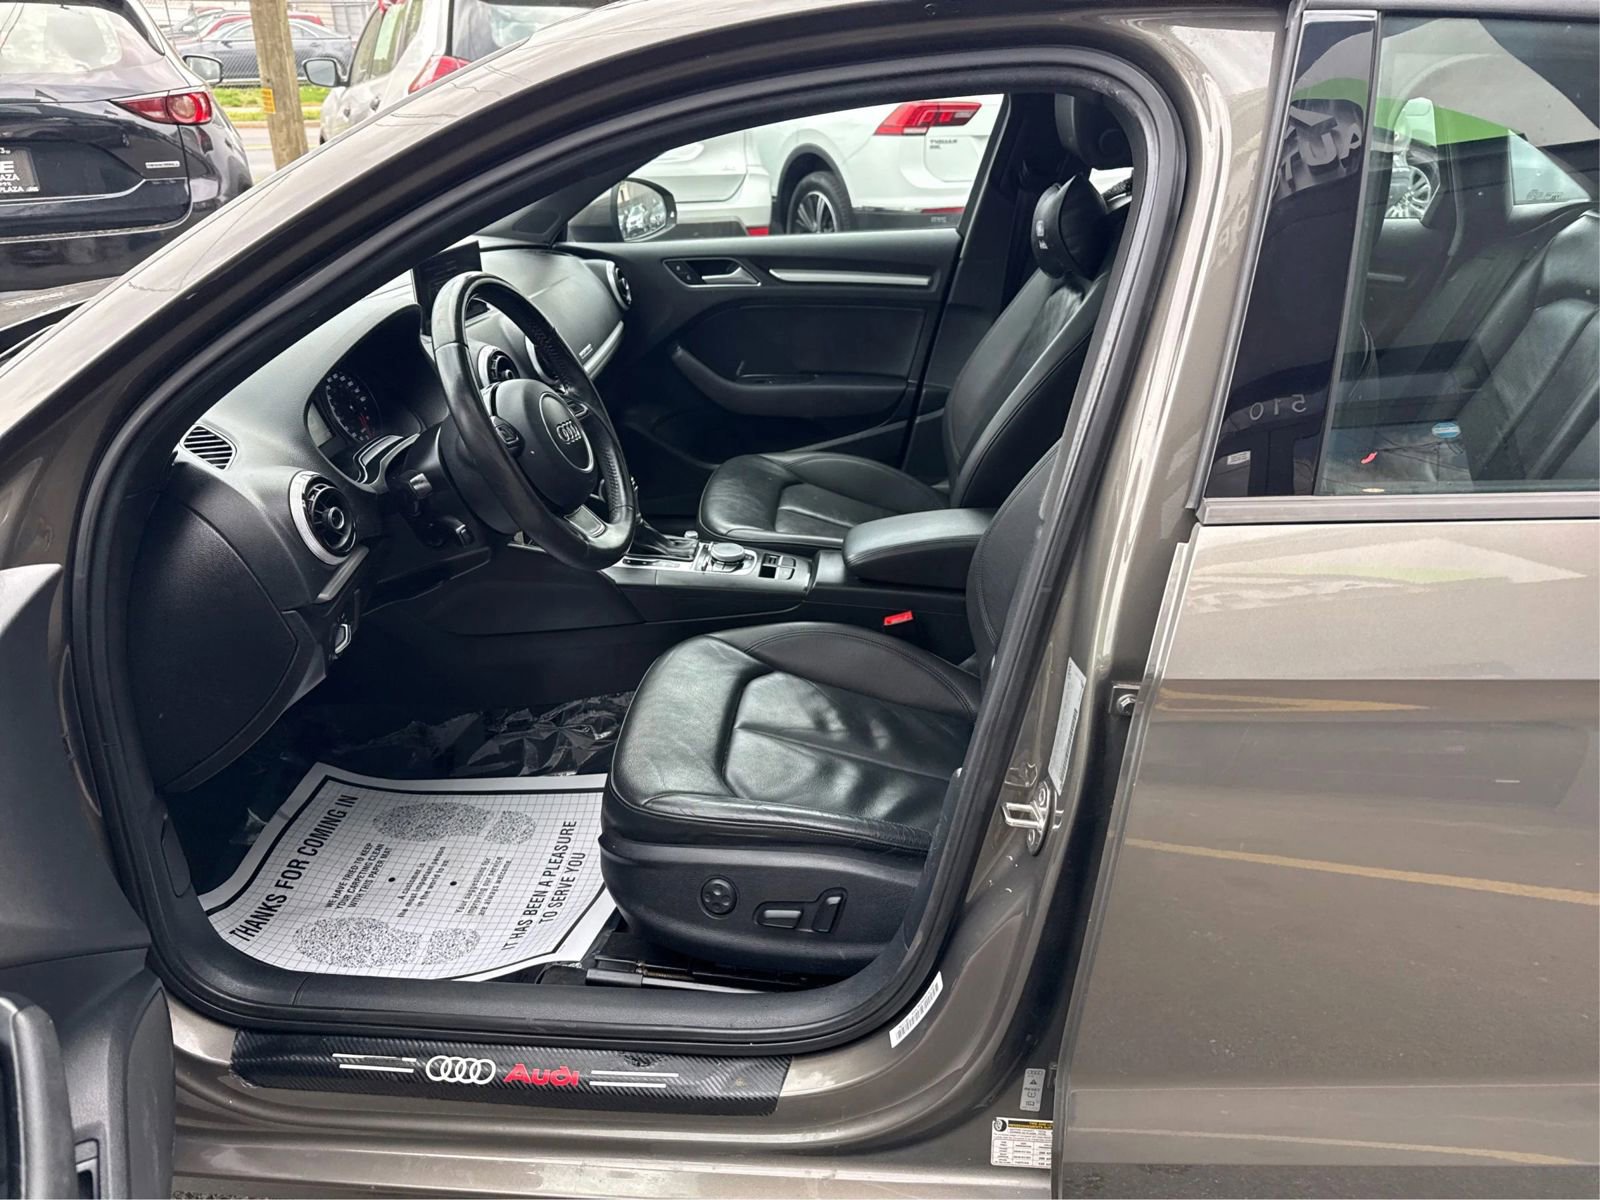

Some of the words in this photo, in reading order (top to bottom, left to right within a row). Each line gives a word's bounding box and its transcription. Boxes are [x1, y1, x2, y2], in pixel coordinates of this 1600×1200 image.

[360, 842, 373, 857] KEEP
[542, 820, 577, 877] PLEASURE
[228, 893, 287, 942] THANKS
[274, 858, 310, 890] FOR
[297, 808, 348, 857] COMING
[335, 794, 359, 808] IN
[353, 856, 365, 865] TO
[564, 852, 586, 874] YOU
[335, 894, 351, 909] YOUR
[346, 861, 374, 894] CARPETING
[367, 843, 385, 861] CLEAN
[342, 865, 359, 881] TRIED
[347, 893, 364, 907] WITH
[358, 879, 374, 893] THIS
[367, 860, 385, 878] PAPER
[380, 847, 393, 858] MAT
[538, 879, 554, 888] A
[331, 881, 348, 898] HAVE
[548, 876, 576, 908] SERVE
[325, 899, 338, 907] WE
[522, 890, 548, 916] BEEN
[538, 911, 559, 925] TO
[508, 919, 534, 940] HAS
[501, 940, 519, 950] IT
[503, 1063, 580, 1086] Audi
